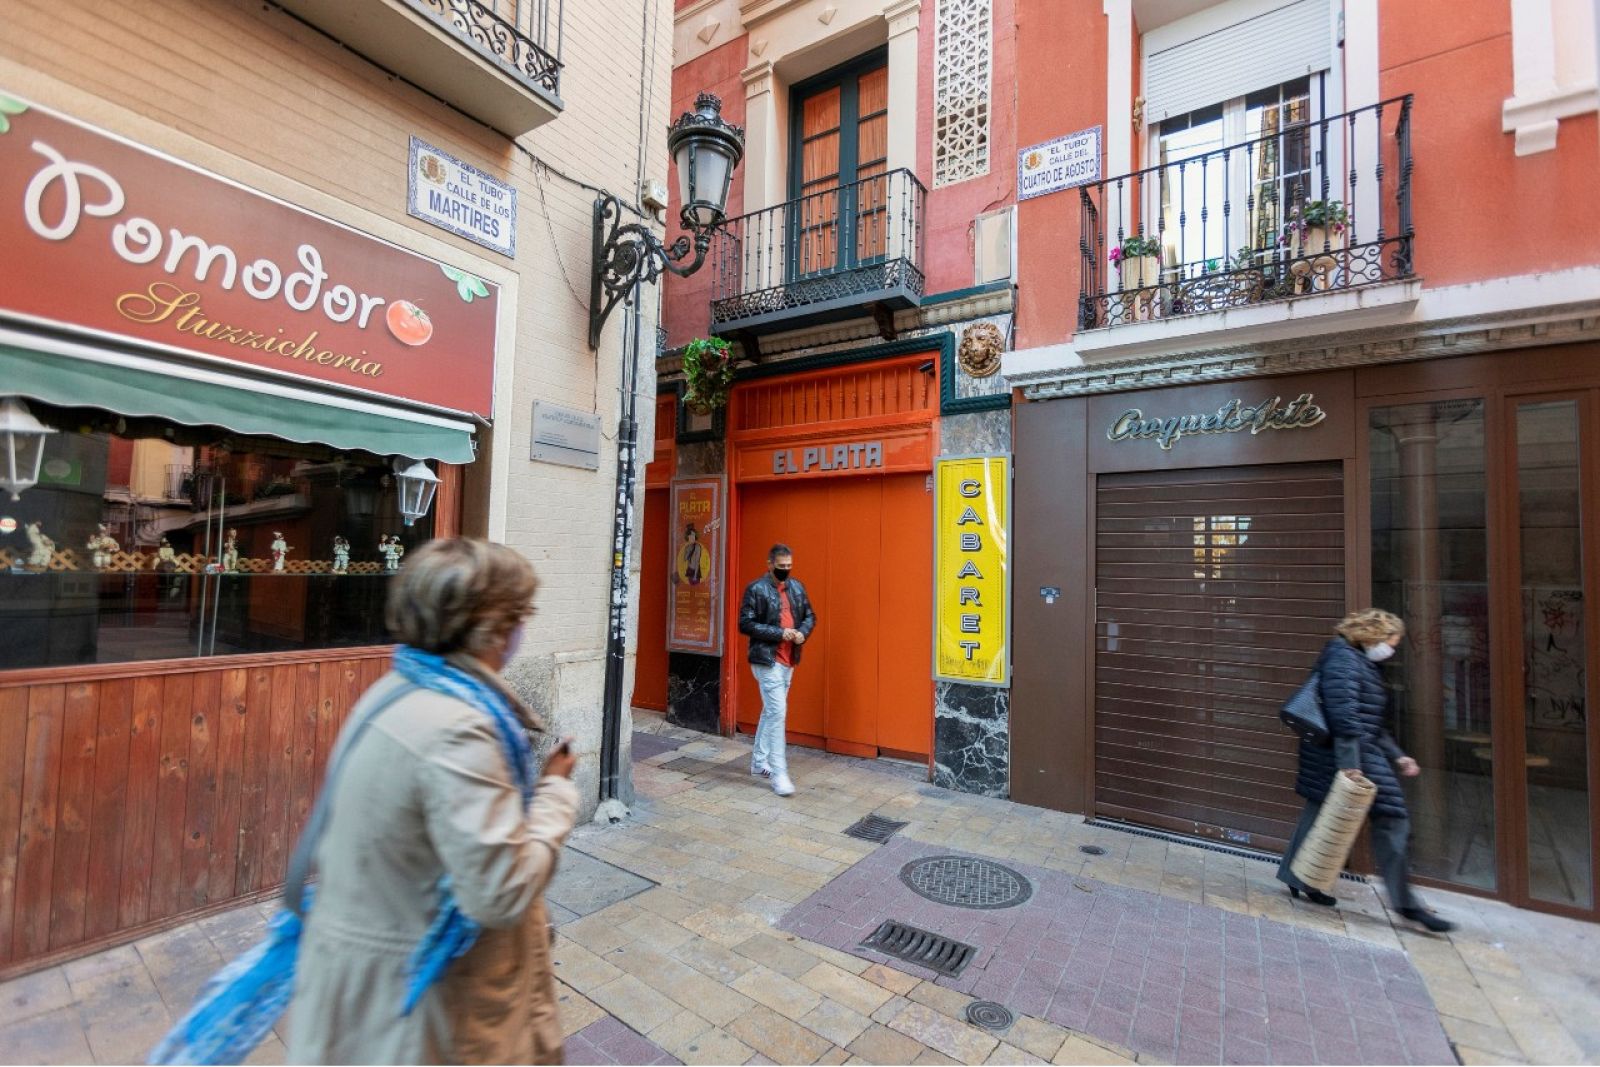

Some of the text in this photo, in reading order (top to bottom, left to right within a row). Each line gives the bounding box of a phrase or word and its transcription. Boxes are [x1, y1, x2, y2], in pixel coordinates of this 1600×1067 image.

[1023, 158, 1095, 190] CUATRO DE AGOSTO
[1049, 148, 1088, 166] CALLE DEL
[429, 189, 500, 239] MARTIRES
[446, 181, 510, 219] CALLE DE LOS
[115, 281, 384, 378] Stuzzicheria
[773, 441, 883, 474] EL PLATA
[679, 500, 711, 514] PLATA
[957, 478, 984, 660] CABARET
